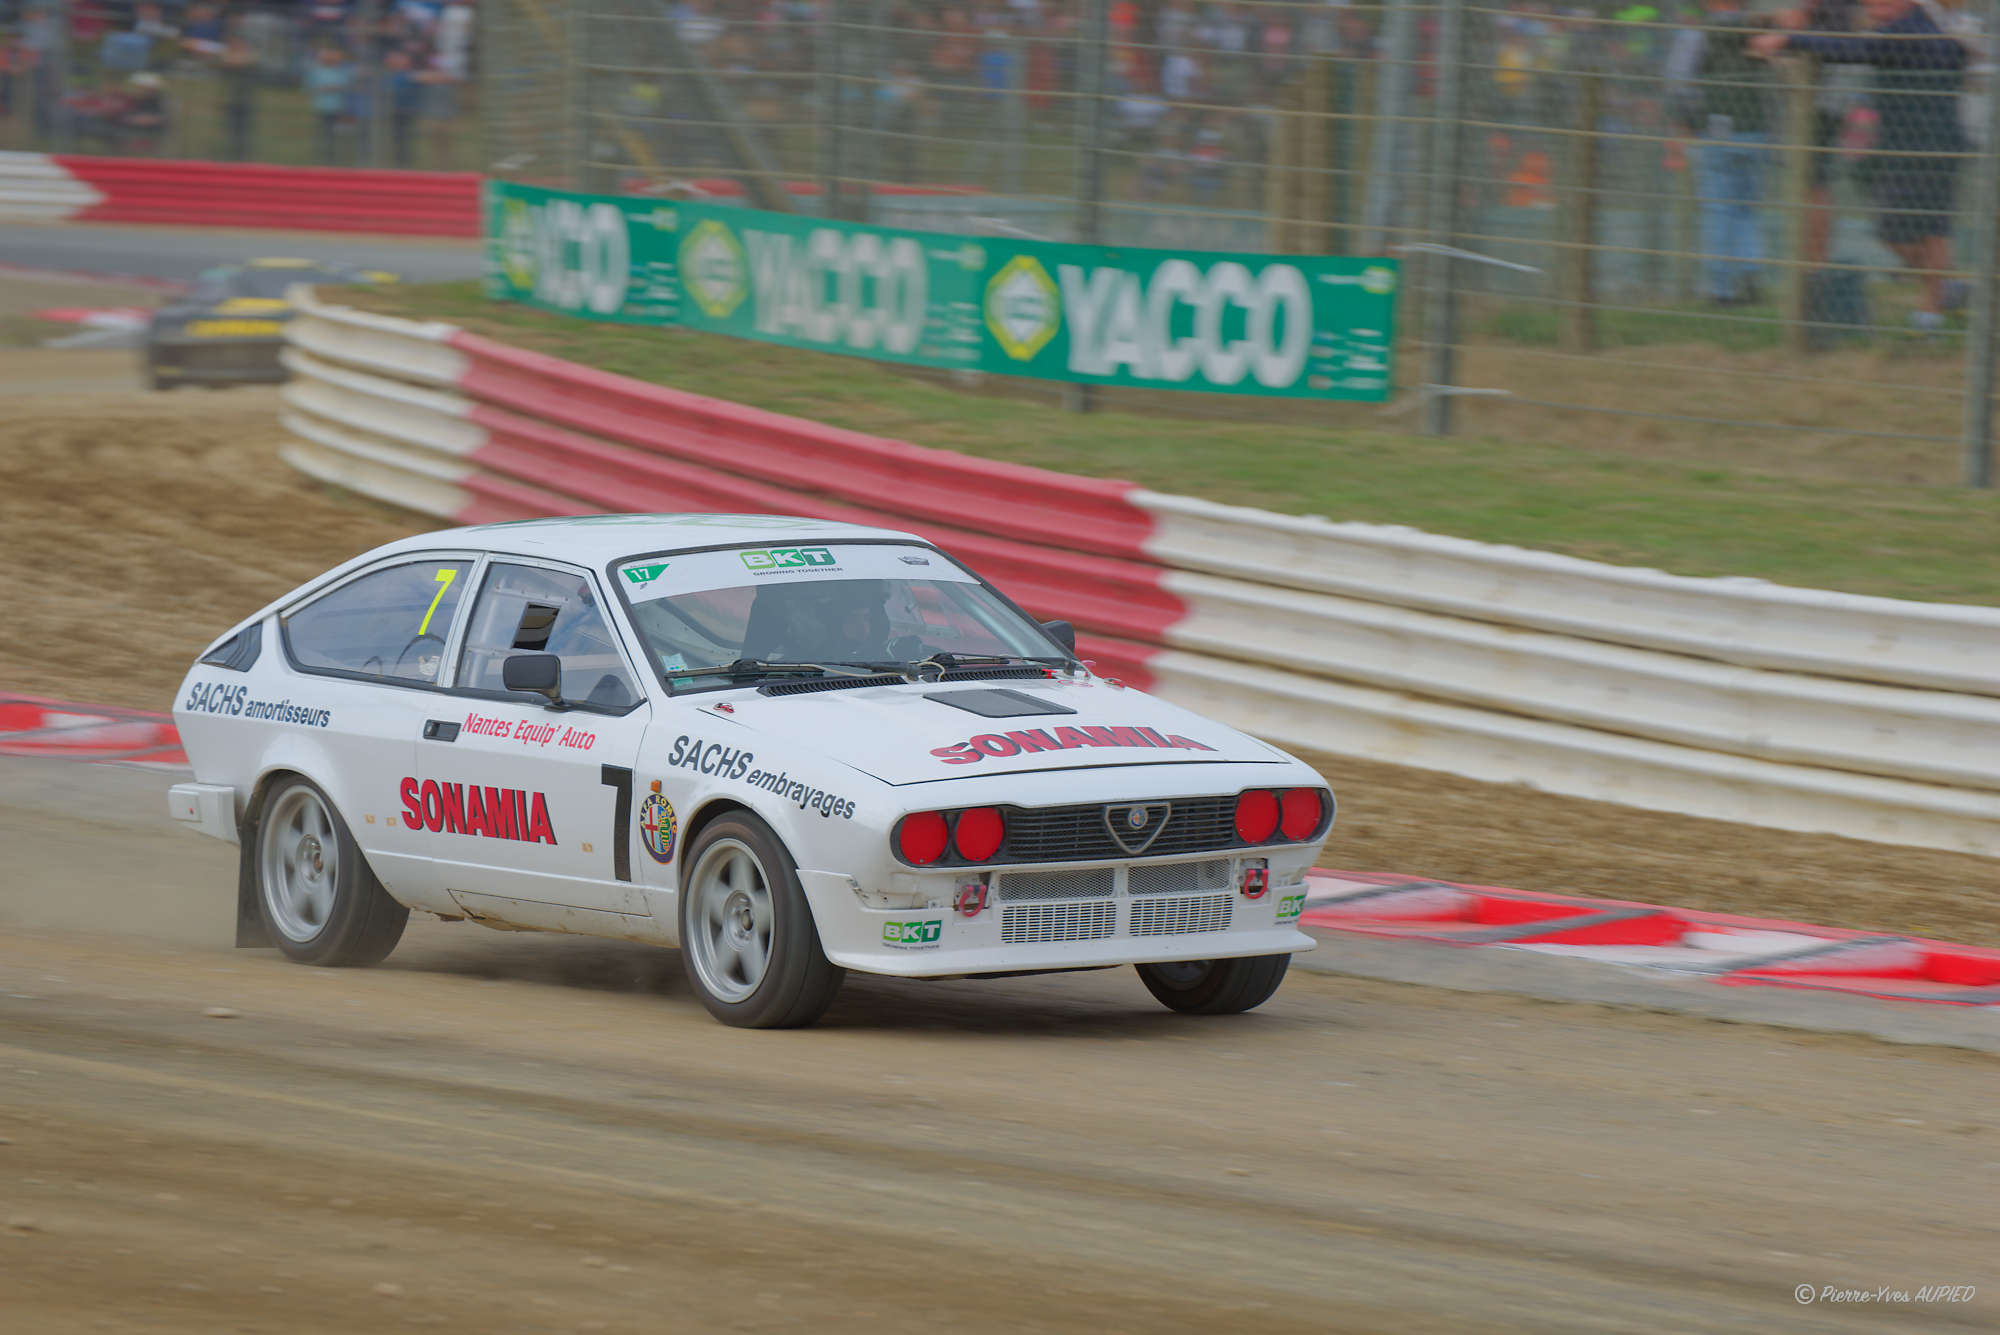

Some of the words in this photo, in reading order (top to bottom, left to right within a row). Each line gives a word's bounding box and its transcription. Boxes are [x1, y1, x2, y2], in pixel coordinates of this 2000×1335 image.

[743, 227, 928, 354] YACCO
[1057, 258, 1313, 388] YACCO
[630, 568, 651, 580] 17
[741, 548, 835, 569] BKT
[418, 569, 457, 635] 7
[186, 682, 248, 716] SACHS
[244, 699, 331, 728] amortisseurs
[462, 713, 513, 739] Nantes
[513, 720, 560, 748] Equip'
[561, 726, 597, 751] Auto
[930, 726, 1218, 764] SONAMIA
[668, 735, 754, 781] SACHS
[746, 768, 856, 819] embrayages
[400, 776, 558, 846] SONAMIA
[601, 764, 632, 882] 7
[884, 921, 942, 942] BKT
